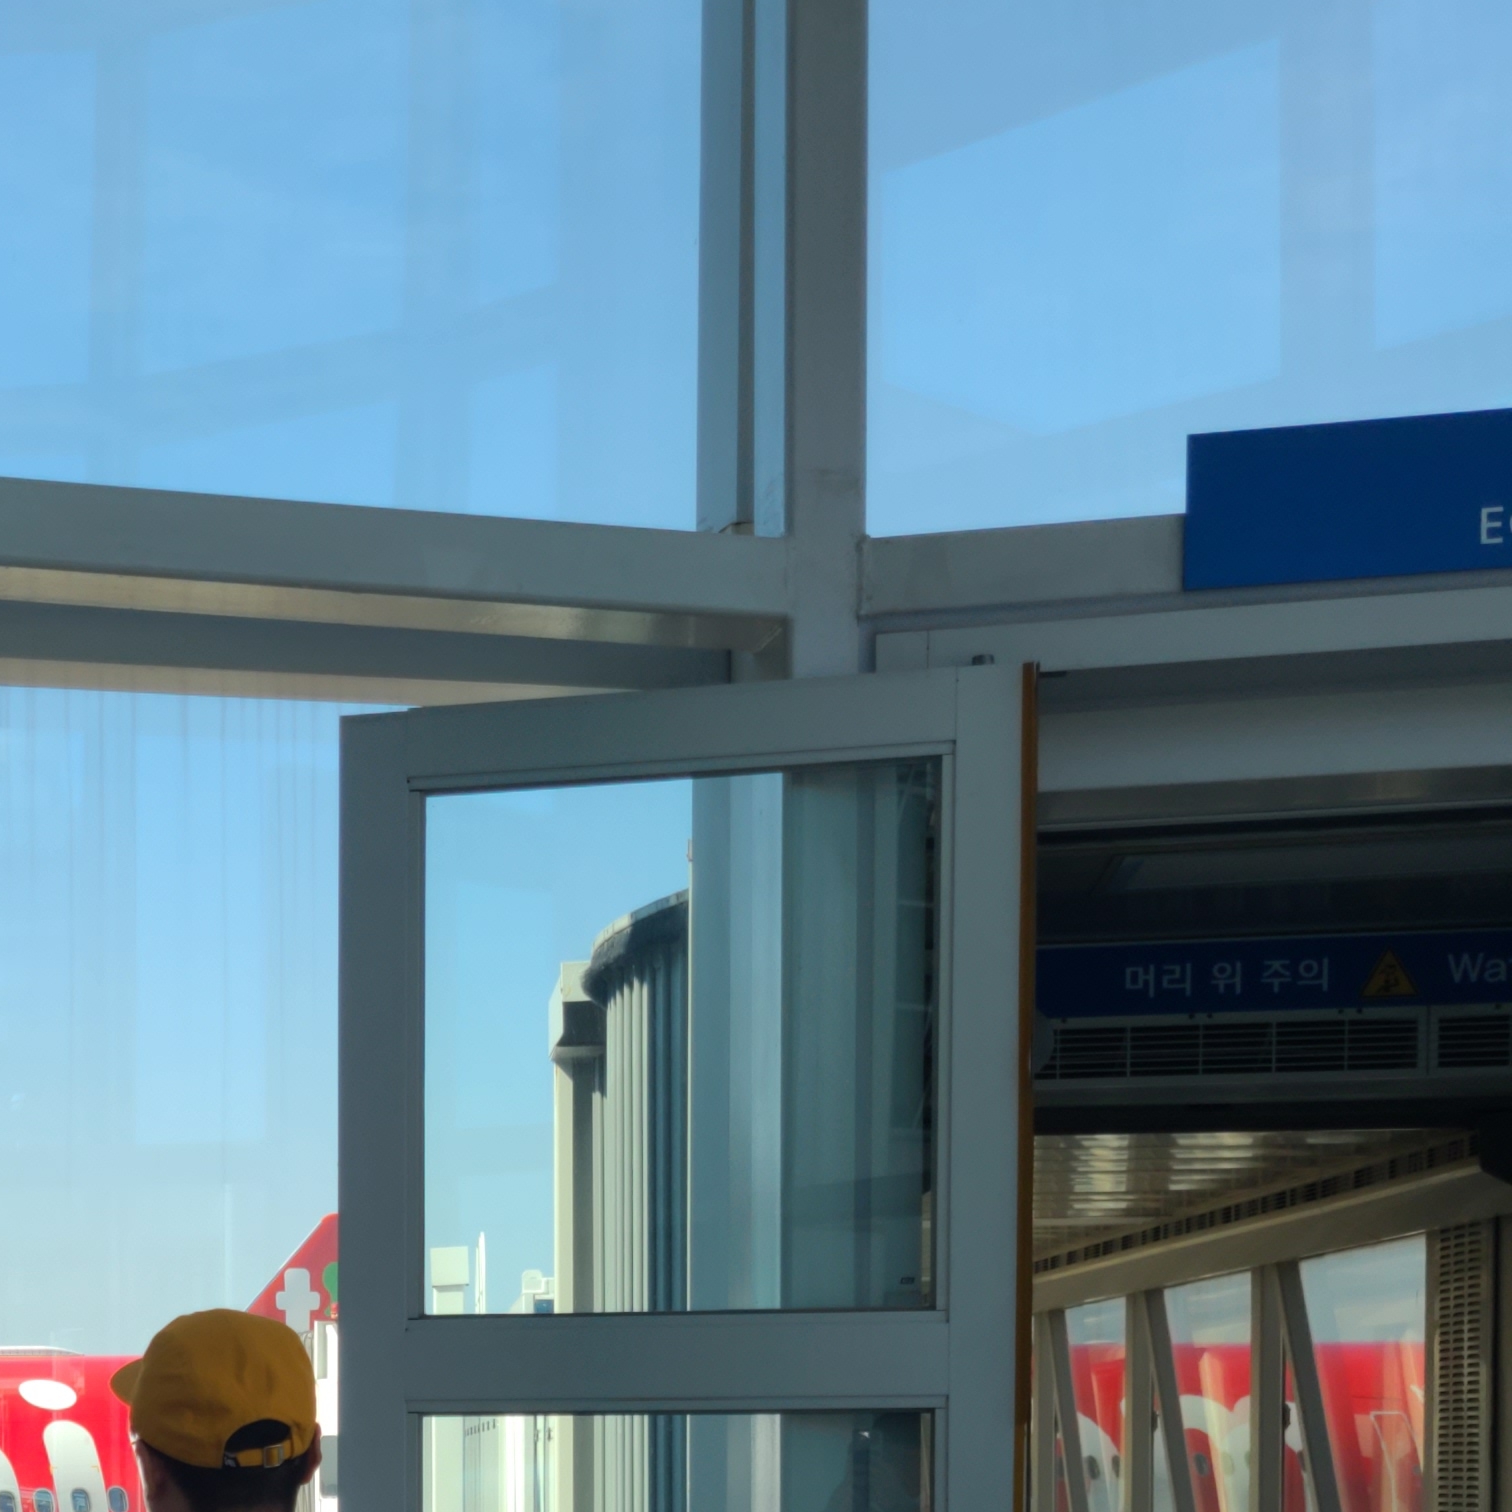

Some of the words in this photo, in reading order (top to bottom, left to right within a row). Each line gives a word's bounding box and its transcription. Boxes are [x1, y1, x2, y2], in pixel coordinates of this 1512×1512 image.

[1480, 506, 1512, 545] E
[1125, 963, 1191, 998] 머리
[1211, 961, 1243, 994] 위
[1262, 956, 1330, 993] 주의
